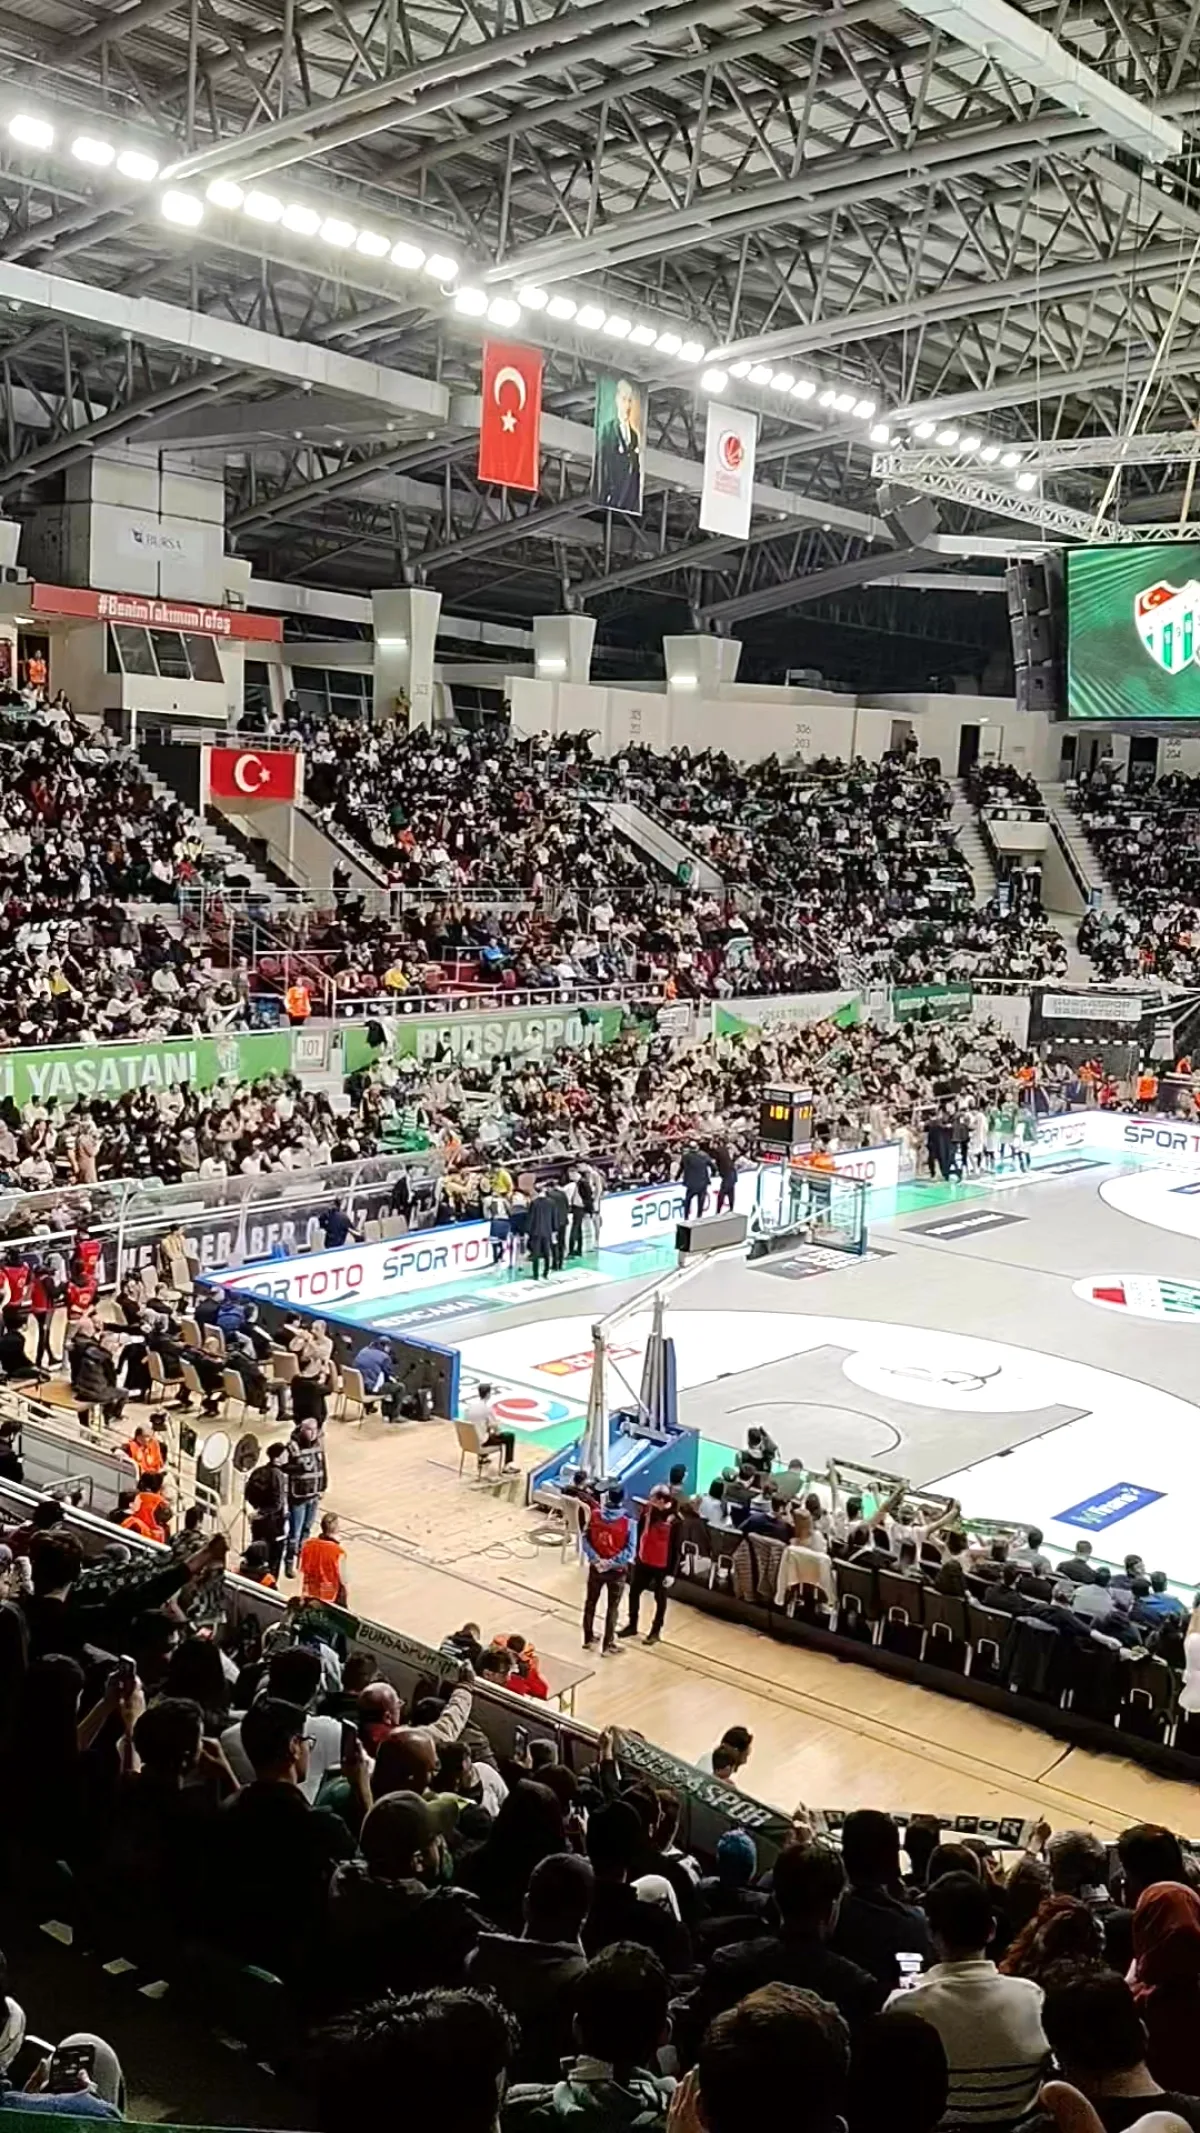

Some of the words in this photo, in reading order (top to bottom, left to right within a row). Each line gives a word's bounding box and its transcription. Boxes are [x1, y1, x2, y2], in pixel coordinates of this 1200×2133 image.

[302, 1040, 320, 1057] 101
[1036, 1121, 1088, 1146] PORTOTO
[382, 1238, 512, 1281] SPORTOT
[240, 1263, 364, 1301] ORTOTO
